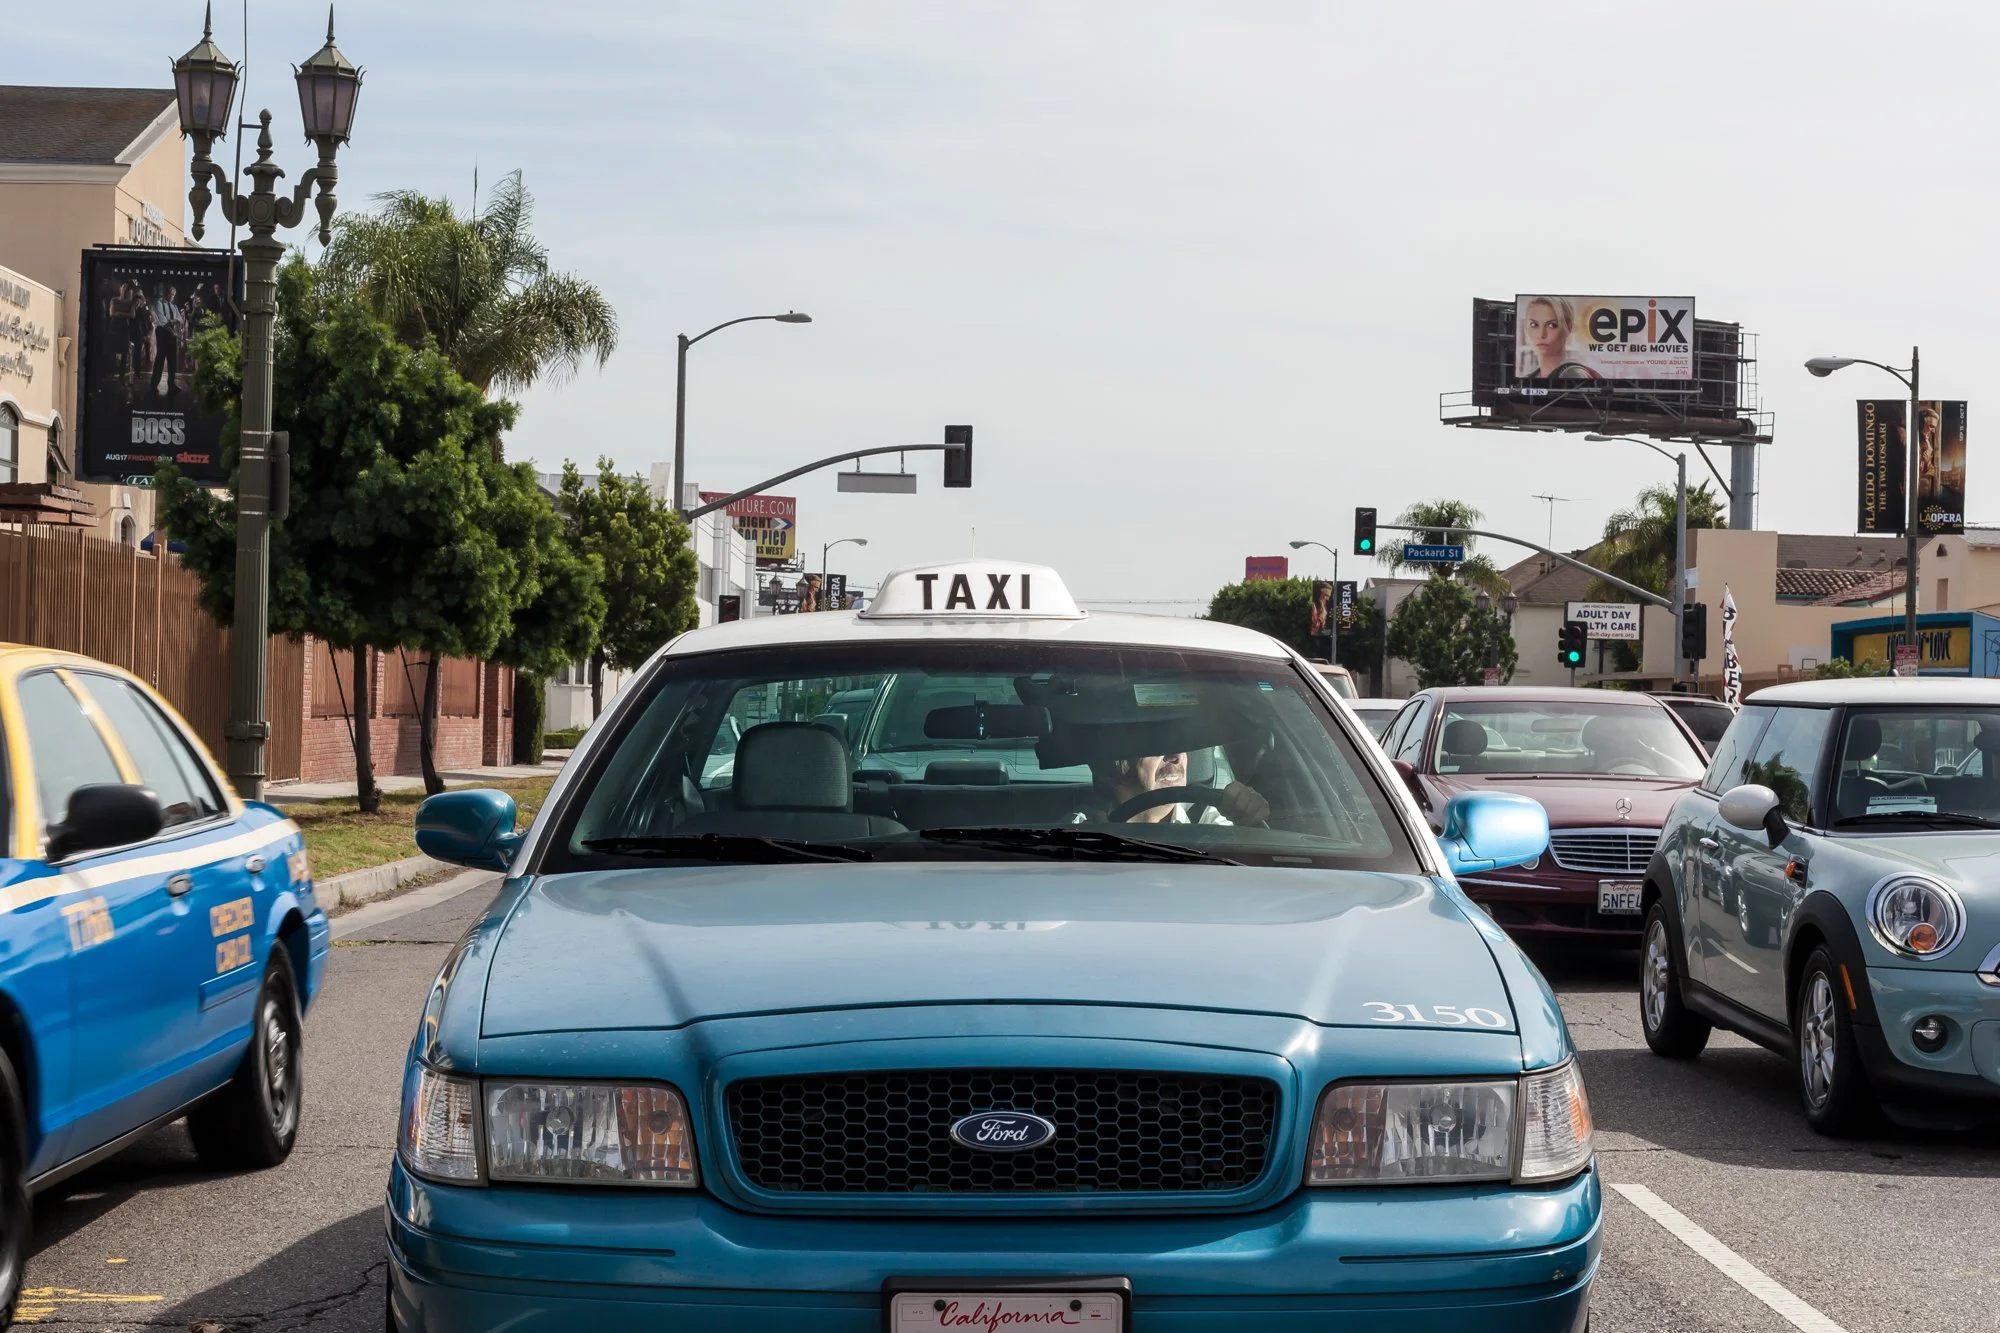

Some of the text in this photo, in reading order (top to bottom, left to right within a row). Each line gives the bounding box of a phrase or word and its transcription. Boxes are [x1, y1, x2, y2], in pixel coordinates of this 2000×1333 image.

[1588, 299, 1688, 343] epix
[1589, 343, 1689, 353] WE GET BIG MOVIES
[131, 417, 186, 445] BOSS
[1864, 402, 1875, 468] DOMINGO
[176, 452, 210, 464] starz
[1879, 423, 1887, 512] THE TWO FOSCARI
[739, 516, 773, 529] RIGHT
[762, 530, 787, 546] PICO
[765, 547, 784, 556] WEST
[1408, 547, 1459, 558] Packard St
[915, 573, 1031, 610] TAXI
[1576, 610, 1631, 619] ADULT DAY
[1611, 622, 1637, 631] CARE
[1361, 1001, 1507, 1028] 3150
[976, 1119, 1029, 1141] Ford
[940, 1301, 1080, 1333] California
